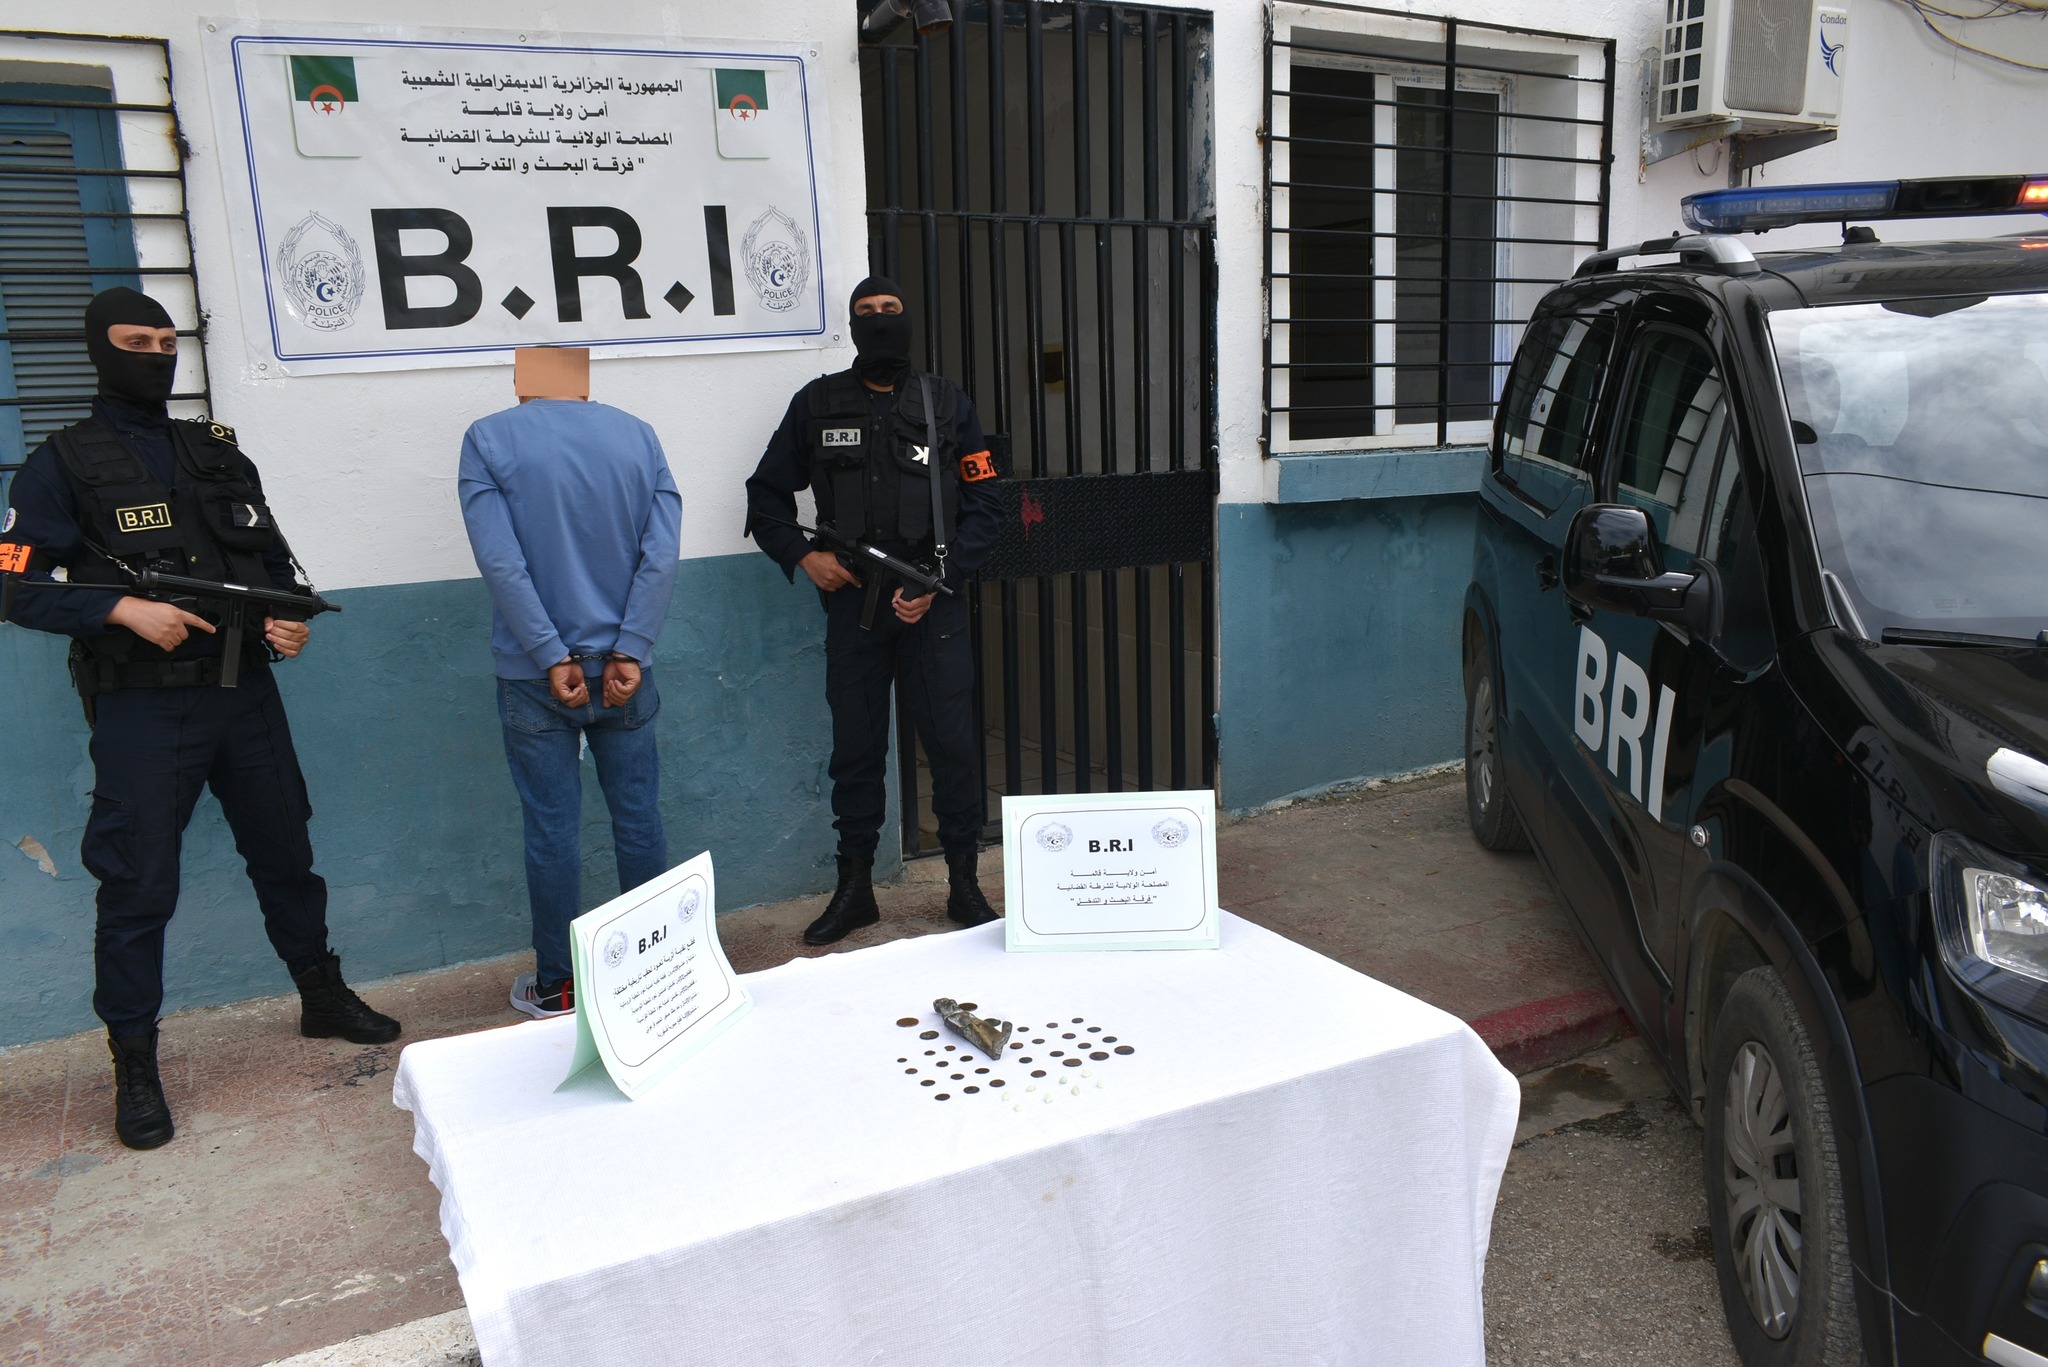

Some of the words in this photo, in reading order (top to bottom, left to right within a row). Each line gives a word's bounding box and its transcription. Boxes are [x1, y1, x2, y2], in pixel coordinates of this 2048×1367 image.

[1820, 13, 1847, 25] Condor
[402, 70, 460, 91] الشعبية
[465, 71, 548, 92] الديمقراطية
[552, 75, 613, 94] الجزائرية
[618, 78, 683, 95] الجمهورية
[462, 101, 523, 116] قالمة
[527, 102, 573, 120] ولاية
[578, 101, 609, 120] أمن
[401, 128, 480, 147] القضائية
[485, 129, 550, 147] للشرطة
[556, 130, 612, 148] الولائية
[616, 130, 673, 146] المصلحة
[534, 156, 588, 176] البحث
[763, 287, 794, 299] POLICE
[308, 303, 346, 317] POLICE
[824, 431, 858, 443] B.R.I
[124, 508, 164, 527] B.R.I
[1574, 624, 1676, 823] BRI
[638, 925, 667, 955] B.R.I
